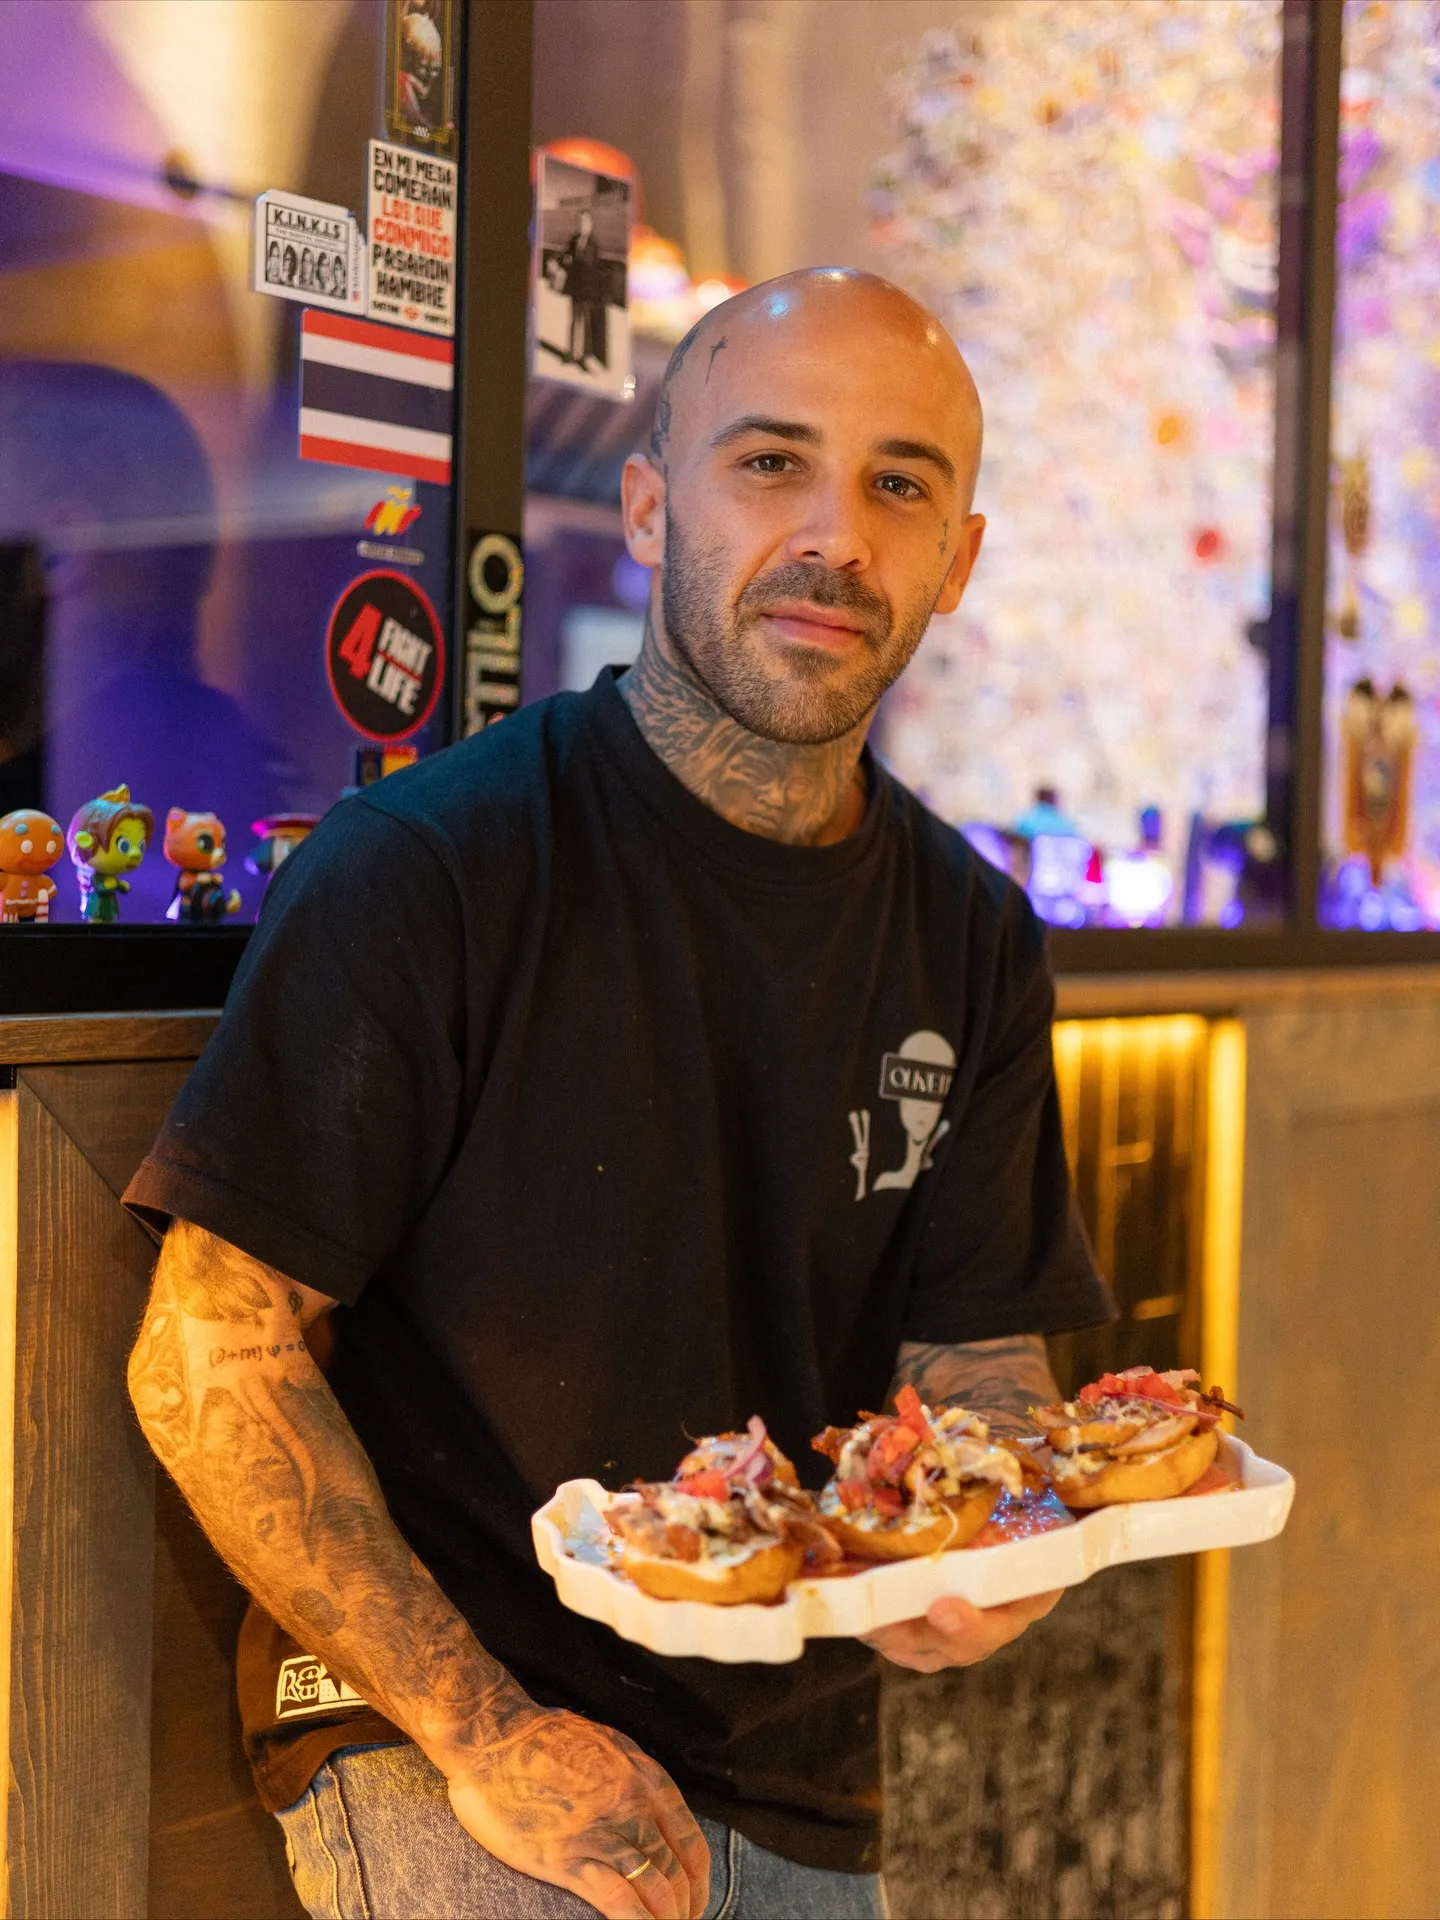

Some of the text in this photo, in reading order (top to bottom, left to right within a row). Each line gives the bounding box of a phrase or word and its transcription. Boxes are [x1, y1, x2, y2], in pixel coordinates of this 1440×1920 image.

[375, 147, 393, 168] EN
[397, 153, 411, 174] MI
[338, 602, 383, 680] 4
[366, 653, 422, 716] LIFE
